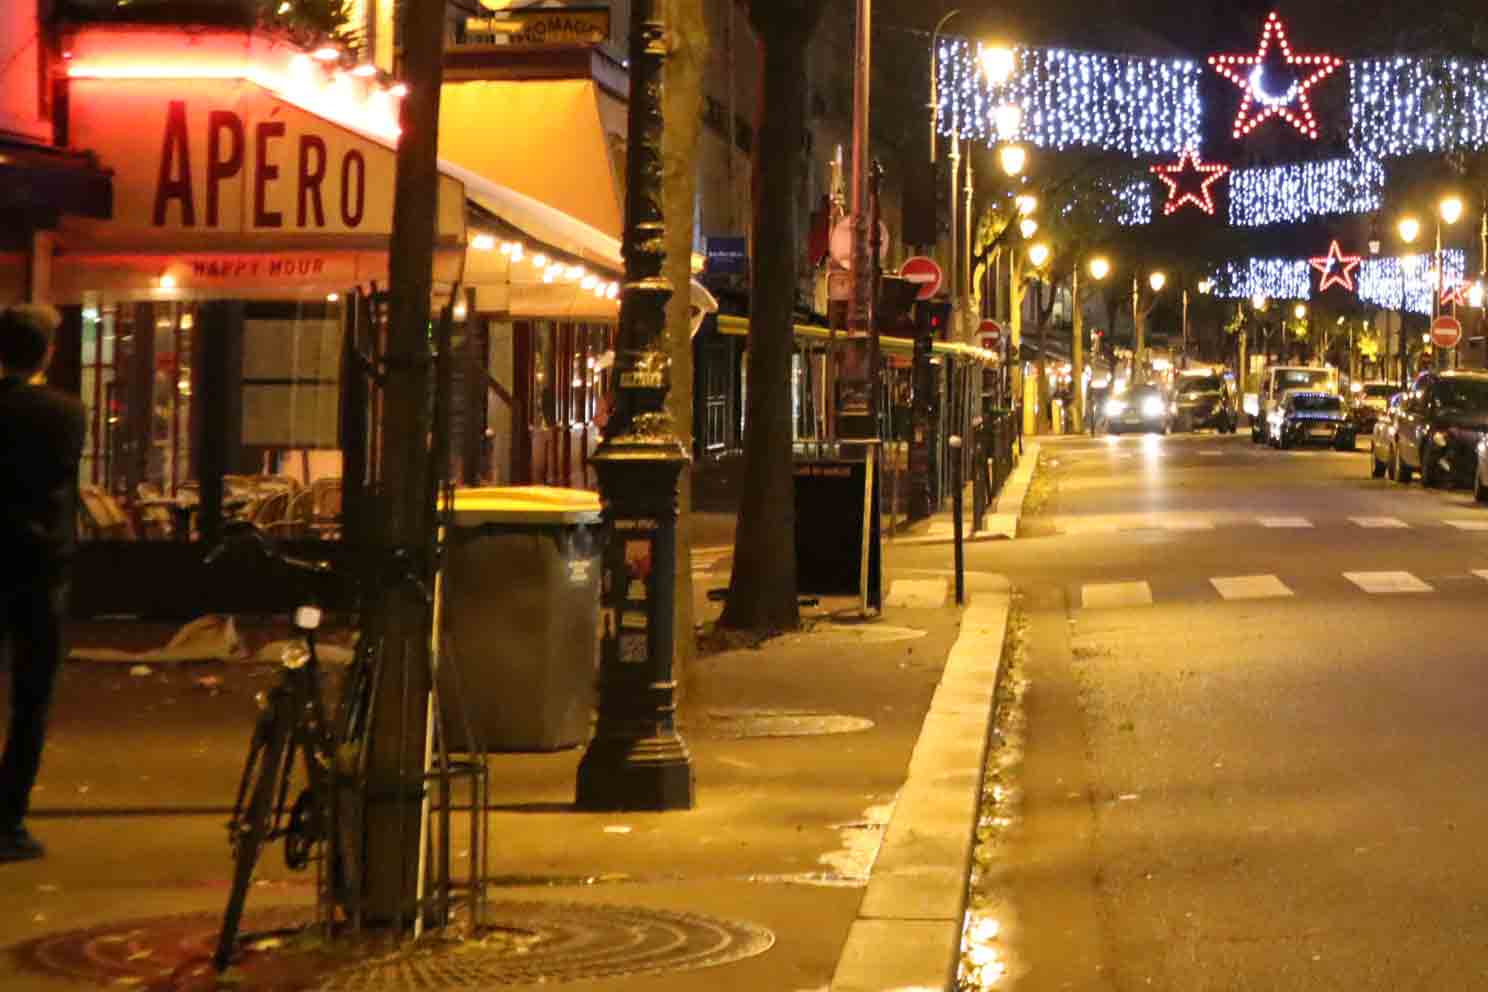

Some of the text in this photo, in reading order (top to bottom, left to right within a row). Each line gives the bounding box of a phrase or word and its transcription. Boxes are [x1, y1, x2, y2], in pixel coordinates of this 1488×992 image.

[151, 100, 366, 229] APÉRO
[192, 258, 325, 277] HAPPY HOUR
